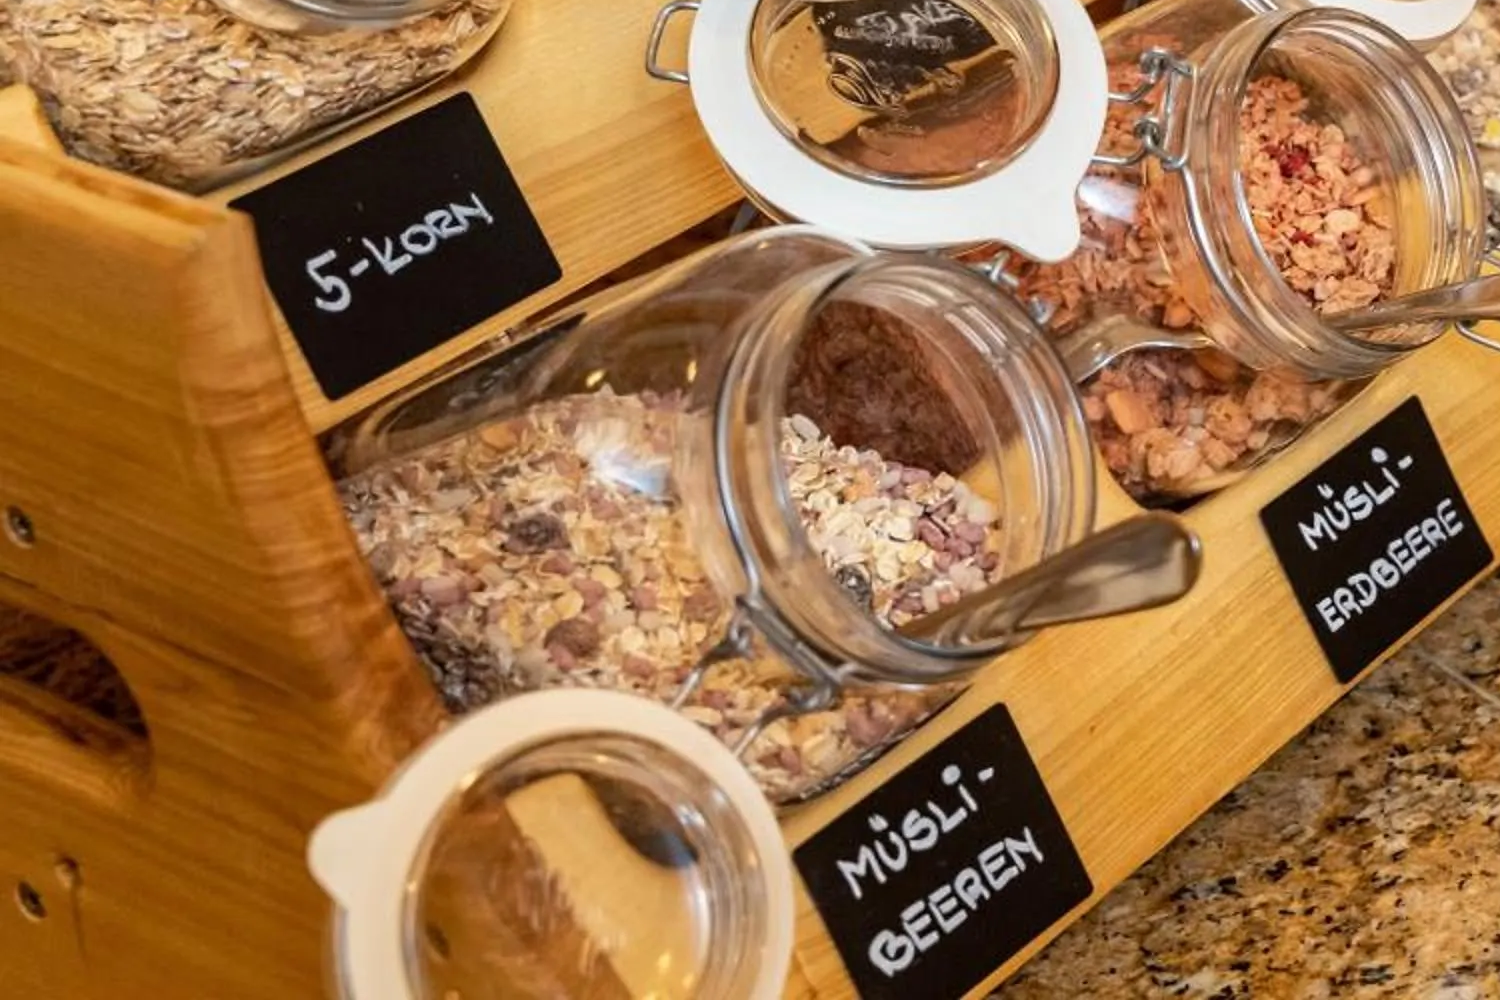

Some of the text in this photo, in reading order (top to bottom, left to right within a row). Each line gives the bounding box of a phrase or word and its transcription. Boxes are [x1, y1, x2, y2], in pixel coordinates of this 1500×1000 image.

[306, 192, 493, 312] 5-KORN
[1315, 498, 1464, 633] ERDBEERE
[868, 826, 1044, 977] BEEREN
